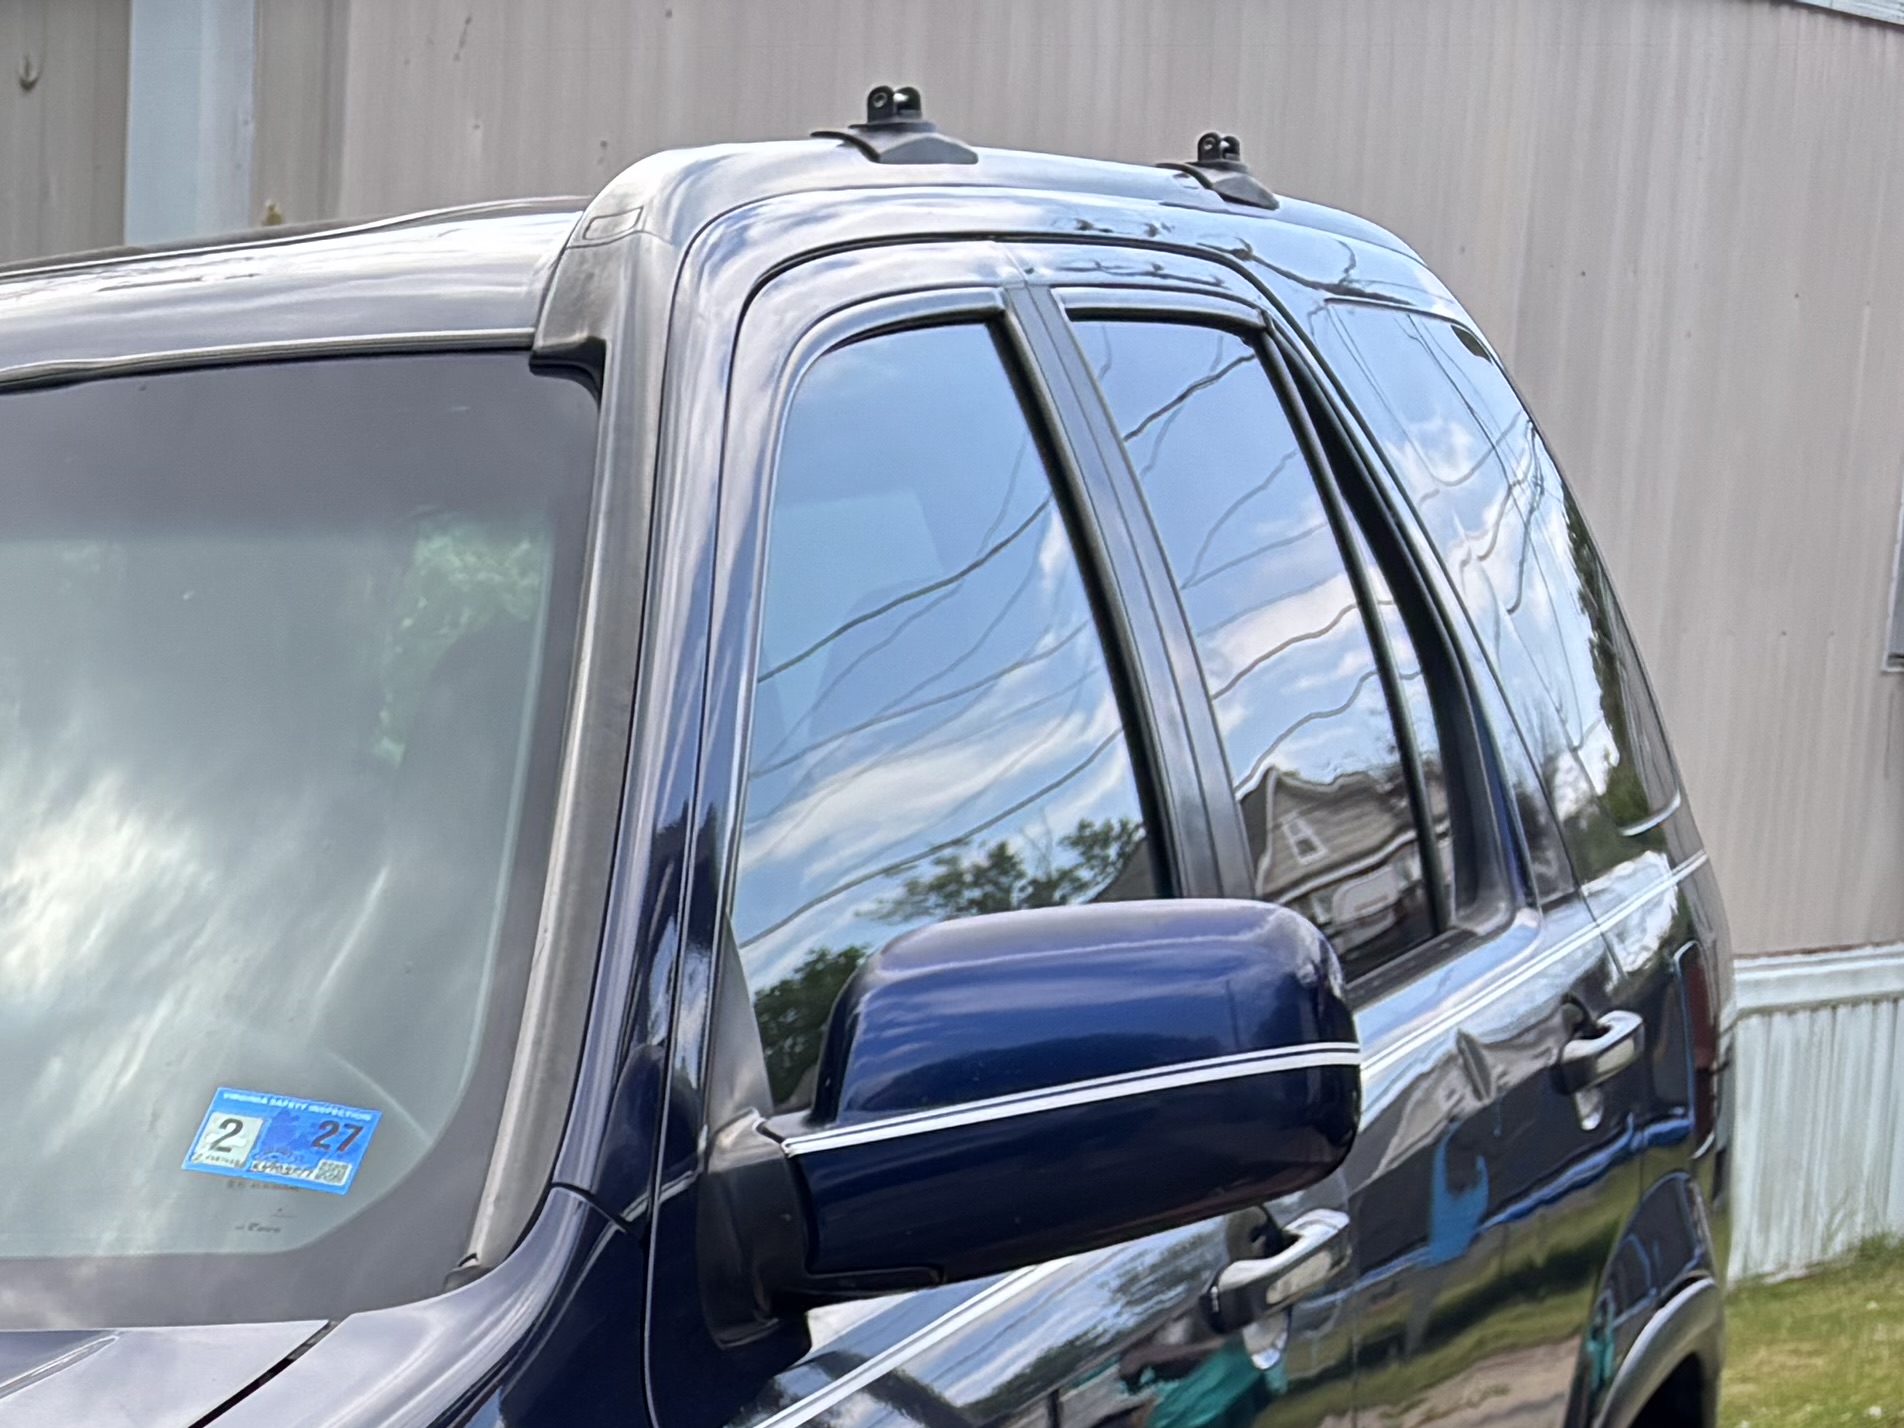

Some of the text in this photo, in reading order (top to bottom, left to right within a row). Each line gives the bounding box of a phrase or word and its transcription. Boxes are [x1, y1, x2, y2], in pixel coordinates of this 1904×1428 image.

[223, 1093, 372, 1121] VIRGINIA SAFETY INSPECTION
[208, 1117, 244, 1153] 2
[311, 1119, 364, 1153] 27
